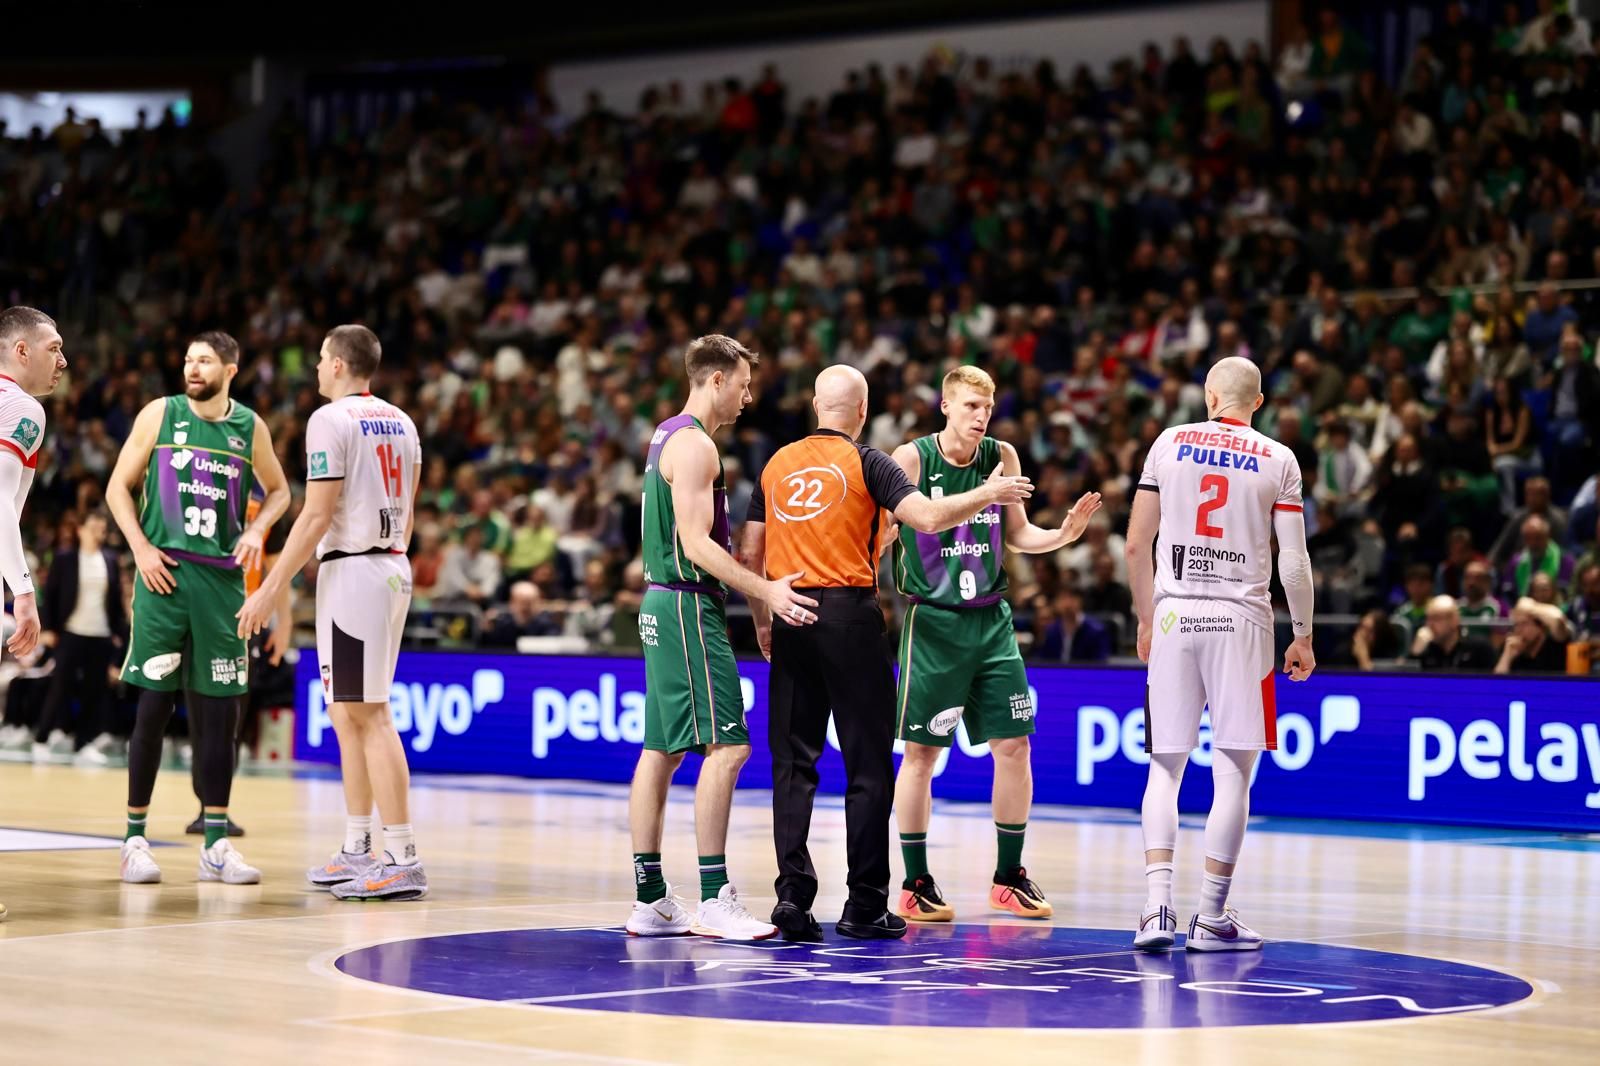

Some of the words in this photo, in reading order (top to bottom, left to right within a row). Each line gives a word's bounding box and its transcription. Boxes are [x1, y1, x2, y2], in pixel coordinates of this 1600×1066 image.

[360, 420, 405, 436] PULEVA
[1173, 431, 1272, 458] ROUSSELLE
[194, 456, 240, 480] Unicaja
[1176, 444, 1259, 473] PULEVA
[376, 443, 402, 497] 14
[787, 477, 822, 508] 22
[1195, 474, 1229, 539] 2
[184, 506, 217, 538] 33
[1188, 559, 1214, 572] 2031
[1189, 546, 1246, 564] GRANADA
[959, 570, 977, 600] 9
[1180, 615, 1233, 625] Diputación
[1180, 625, 1192, 633] de
[1193, 624, 1235, 633] Granada
[1009, 692, 1025, 701] sabor
[1015, 694, 1031, 710] má
[1011, 708, 1033, 721] laga
